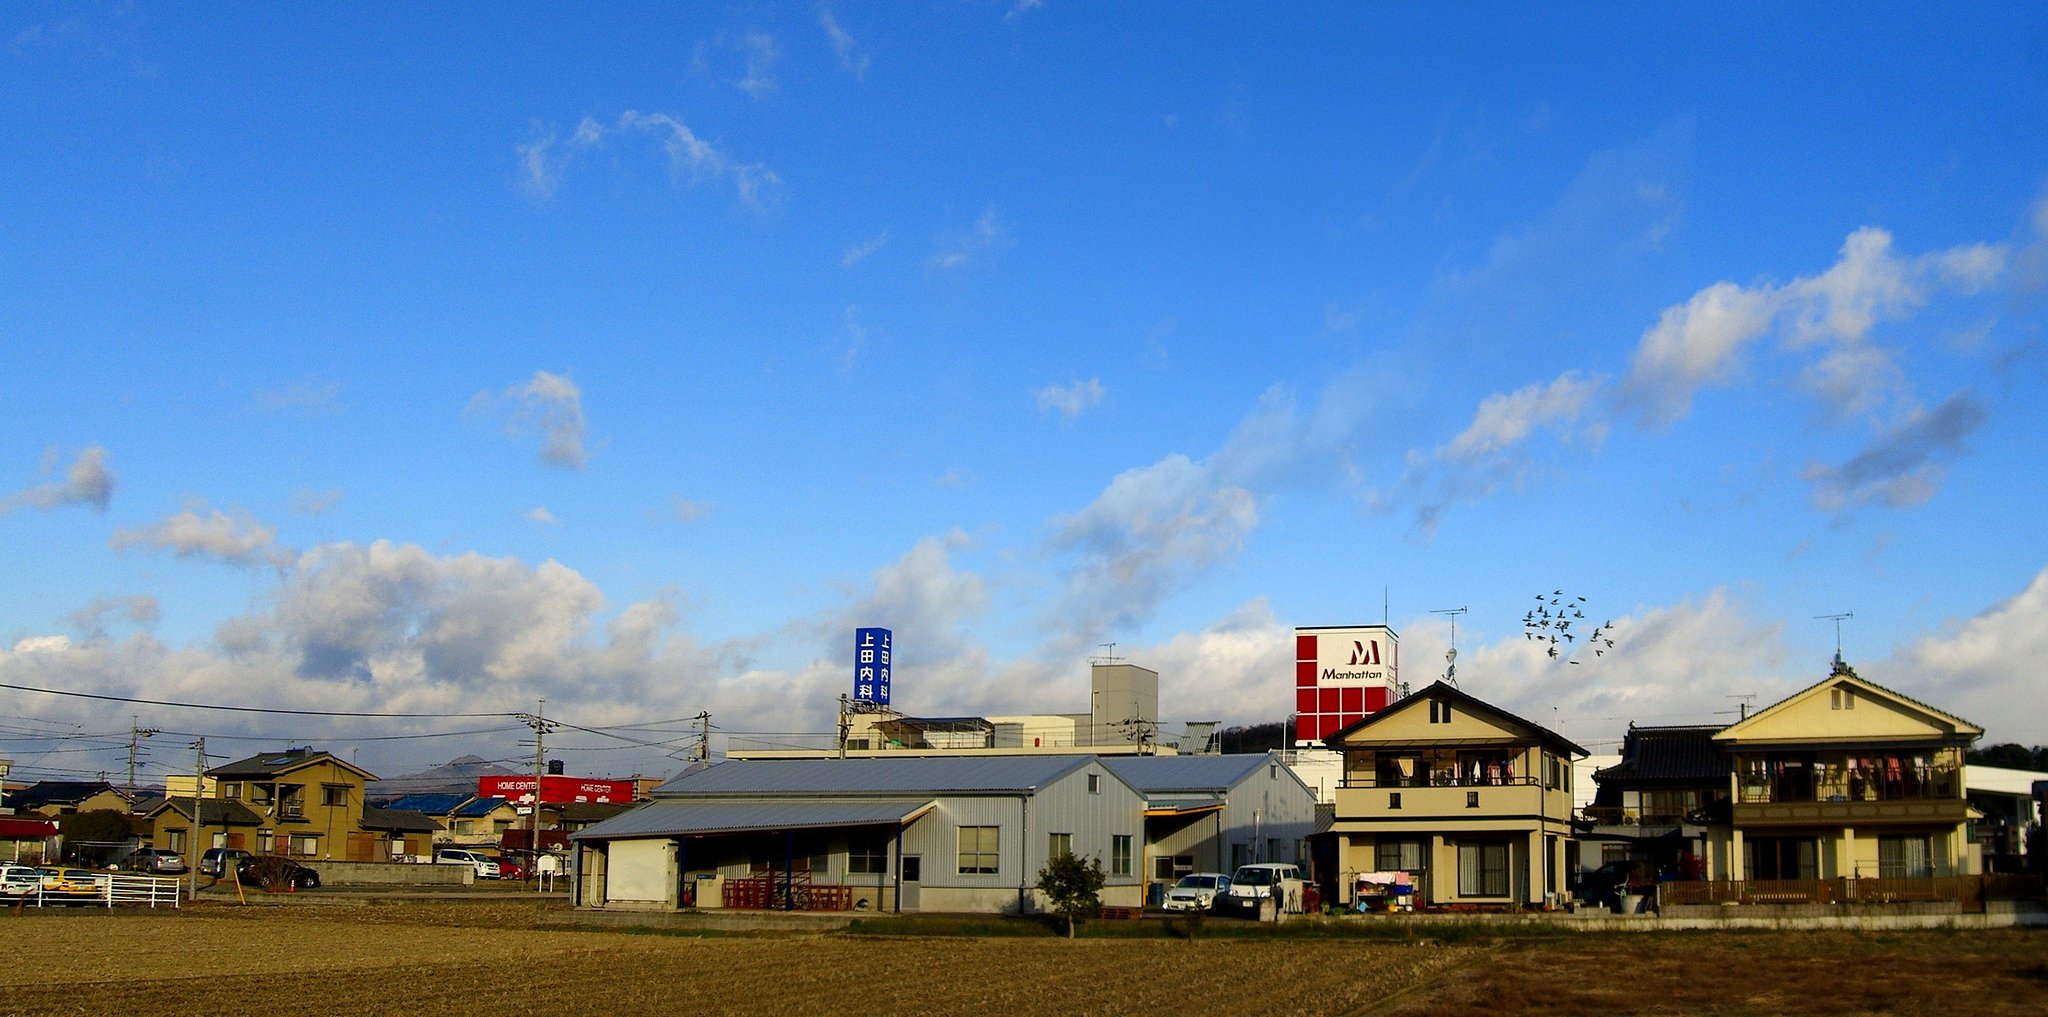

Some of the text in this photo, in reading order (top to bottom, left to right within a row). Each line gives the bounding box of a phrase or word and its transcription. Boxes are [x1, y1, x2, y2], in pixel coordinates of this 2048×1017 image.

[859, 632, 874, 699] 上田内科
[880, 634, 889, 700] 上田内科
[1321, 668, 1382, 680] Manhattan
[497, 782, 515, 790] HOME
[581, 783, 593, 792] HOME
